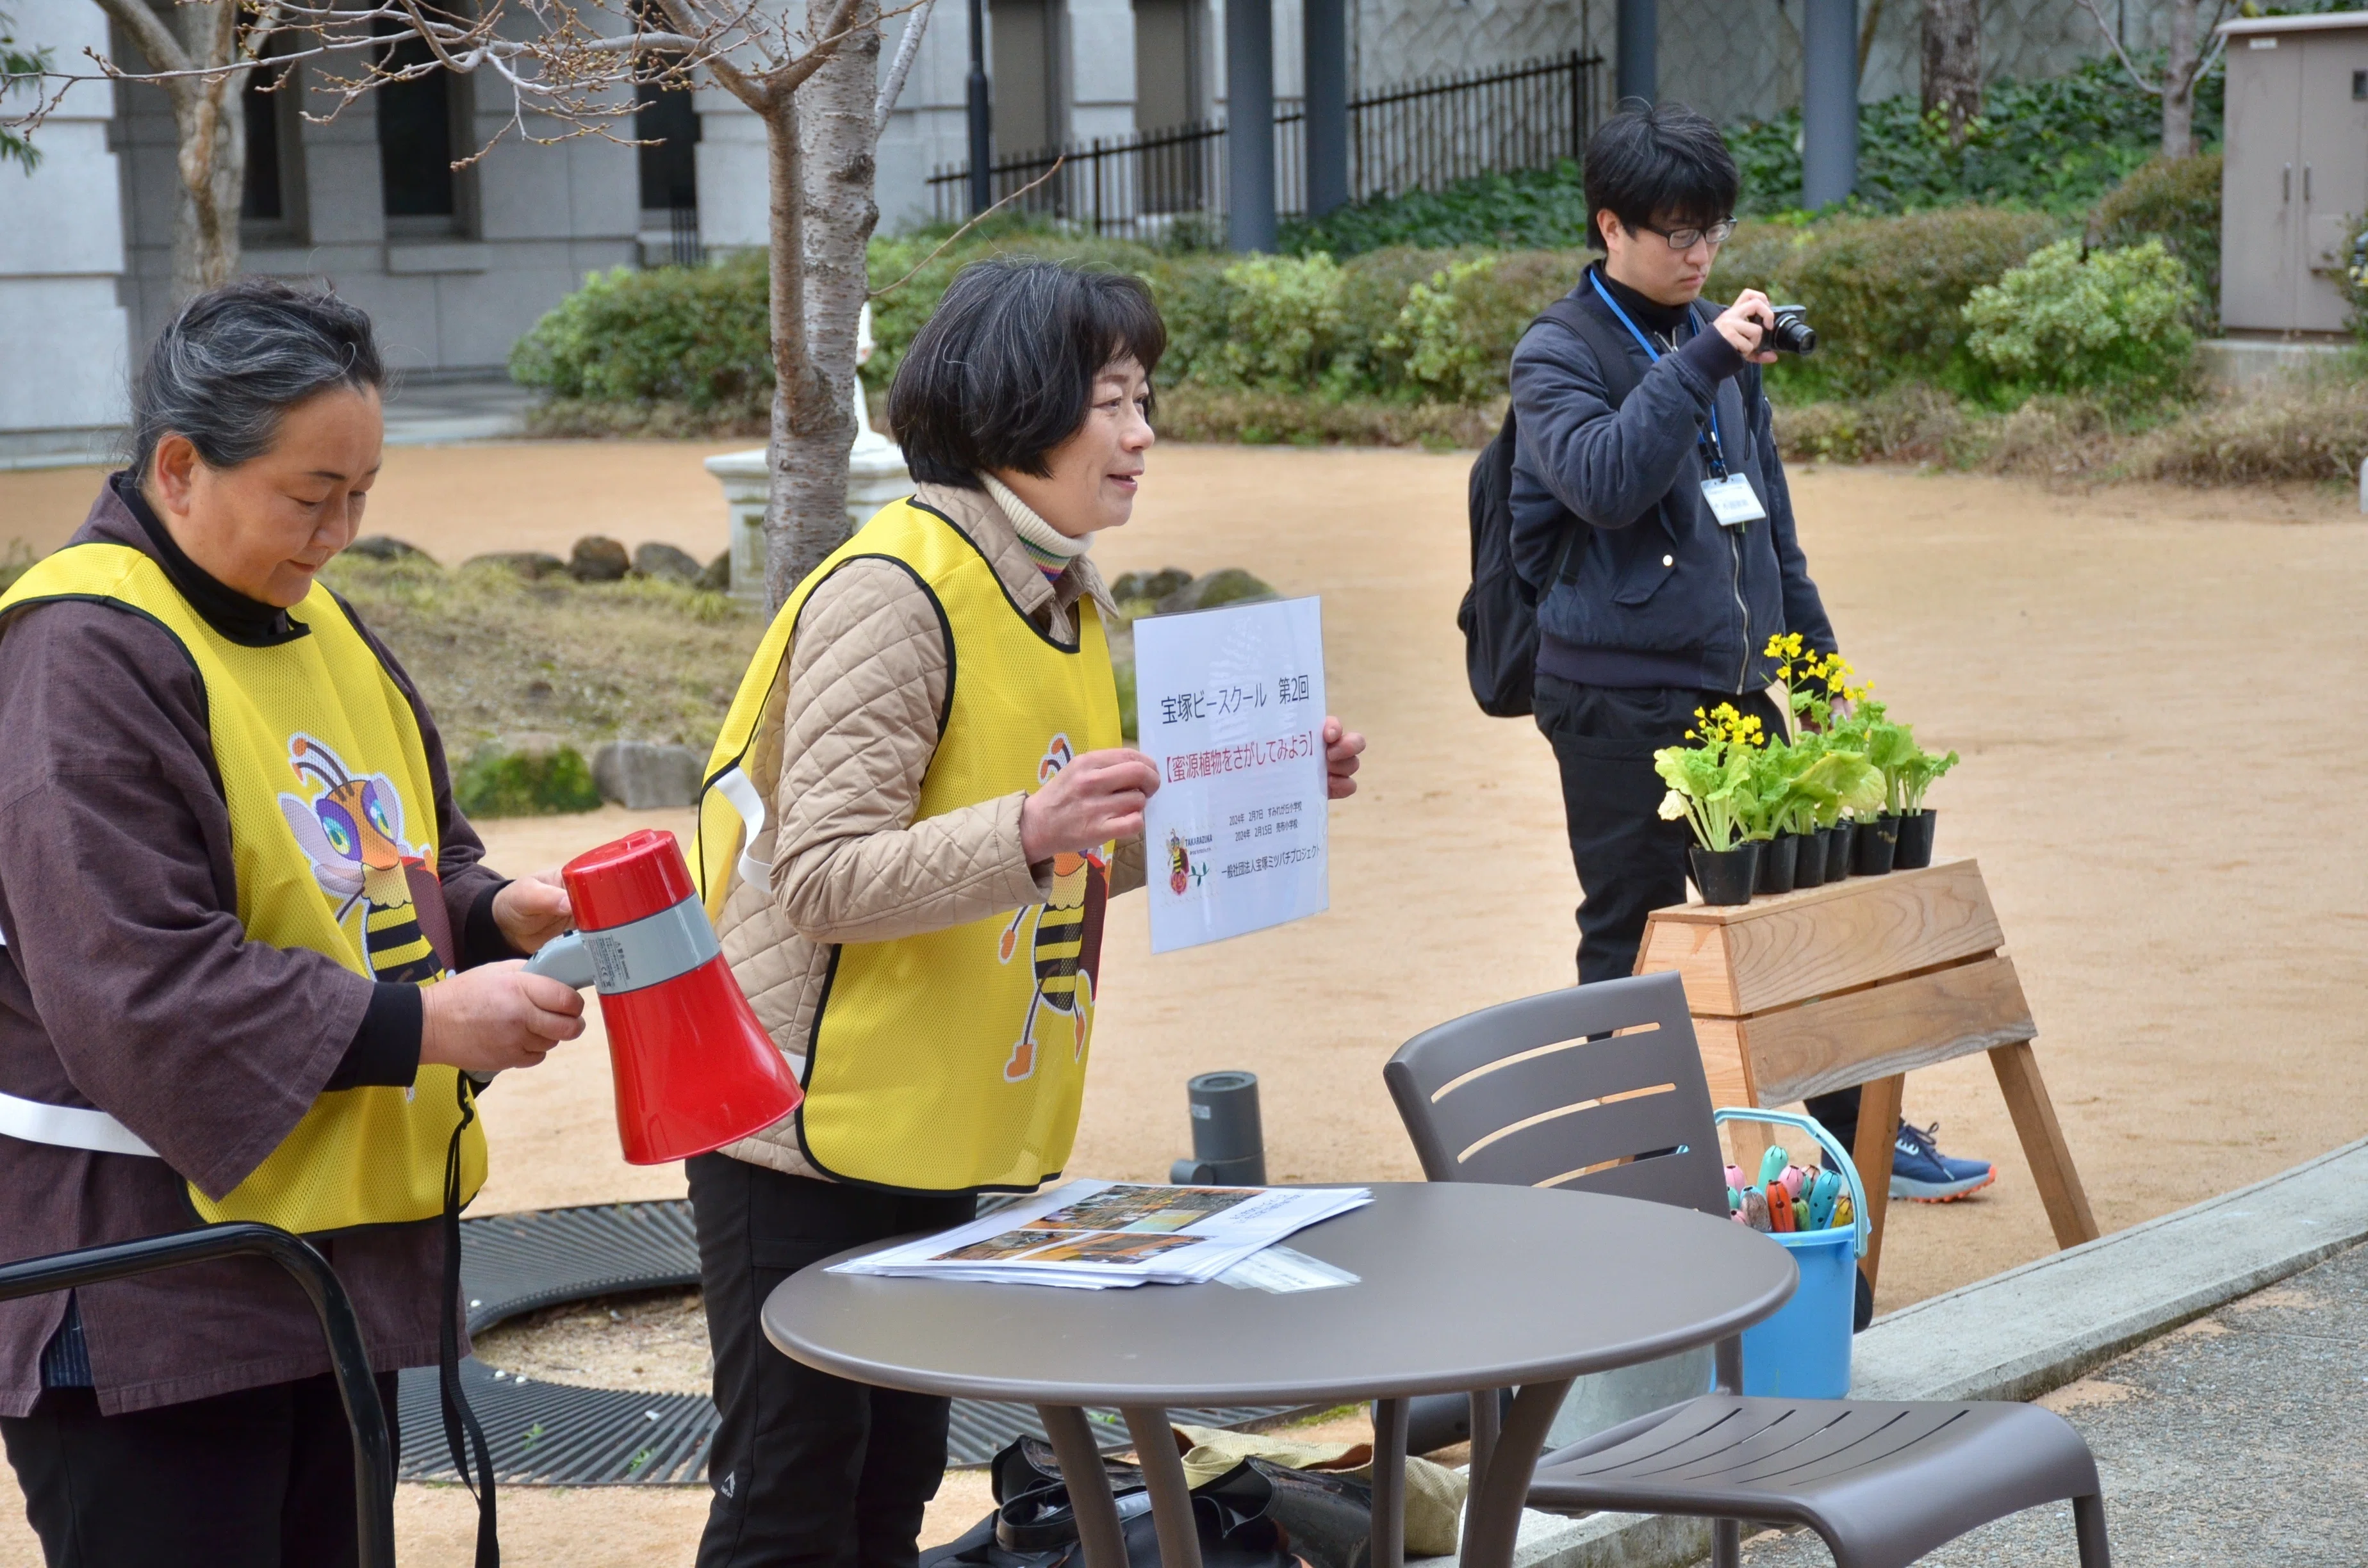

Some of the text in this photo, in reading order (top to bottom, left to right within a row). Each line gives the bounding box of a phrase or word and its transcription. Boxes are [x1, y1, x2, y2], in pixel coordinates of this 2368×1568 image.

[1161, 674, 1309, 724] 宝塚ビースクール 第2回
[1166, 731, 1313, 783] 【蜜源植物をさがしてみよう】
[1229, 813, 1245, 826] 2024年
[1249, 809, 1263, 822] 2月7日
[1185, 834, 1213, 847] TAKARAZUKA
[1235, 829, 1251, 842] 2024年
[1254, 824, 1272, 837] 2月15日
[1221, 844, 1320, 879] 一般社団法人宝塚ミツバチプロジェクト
